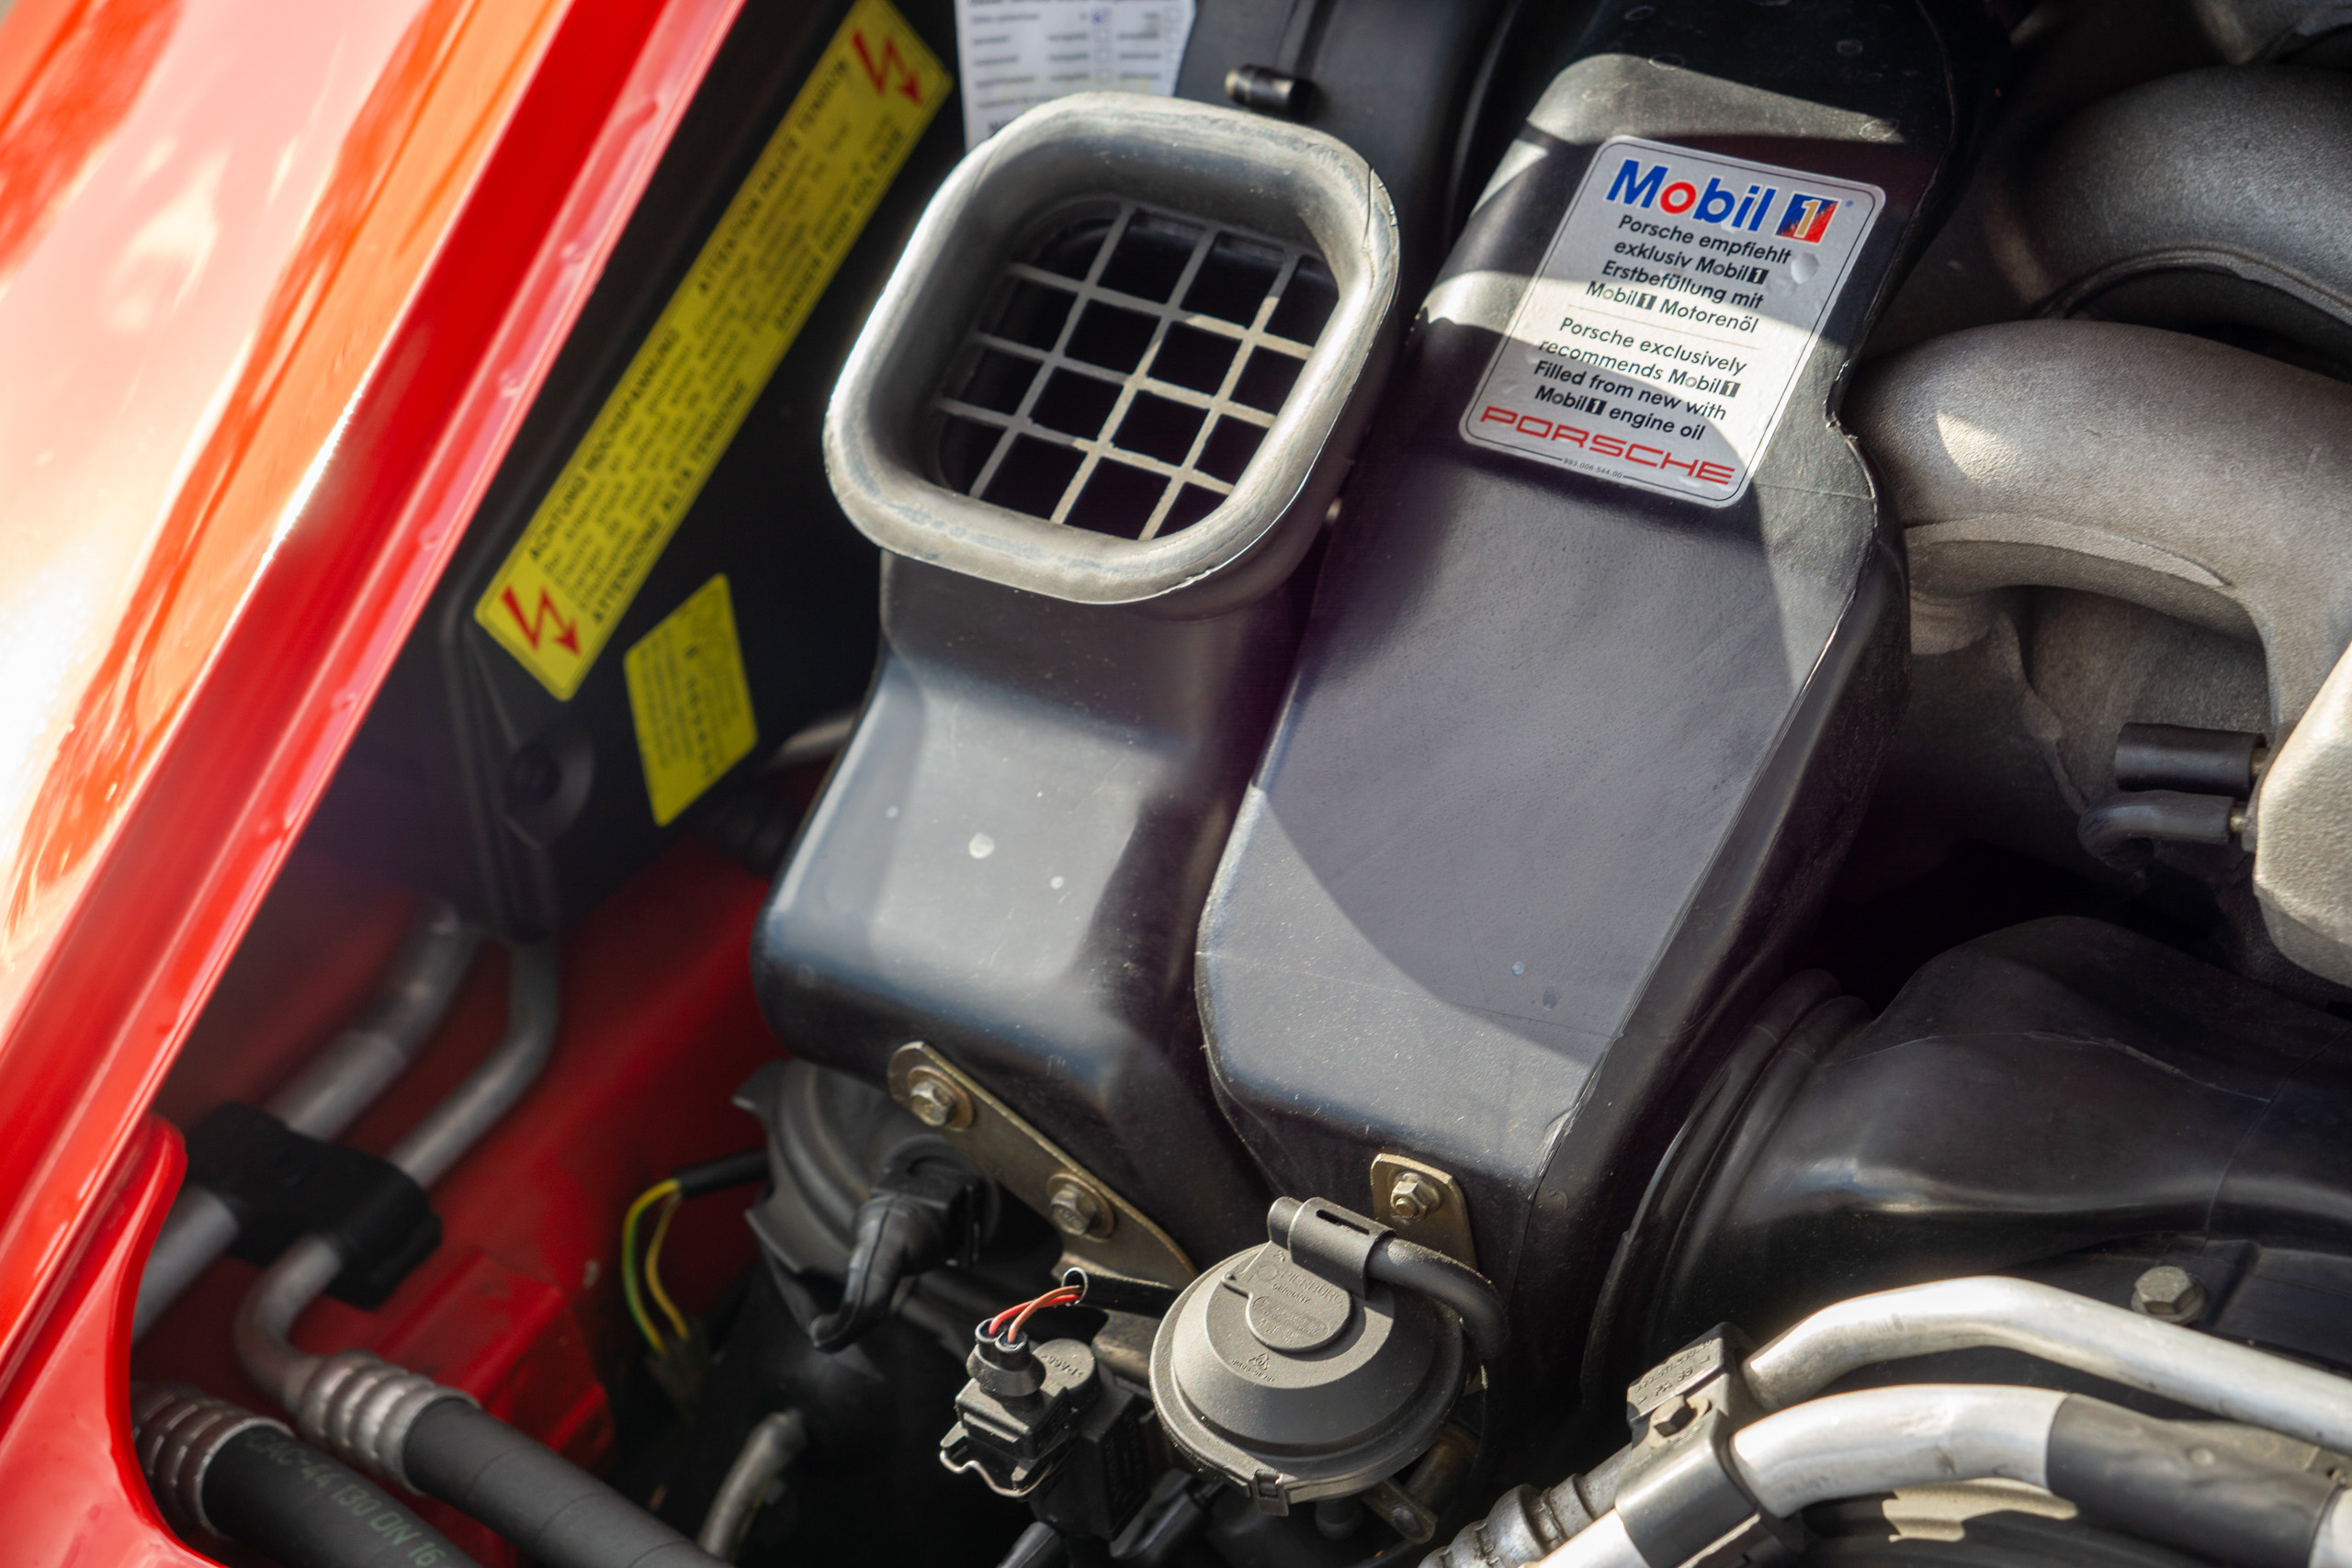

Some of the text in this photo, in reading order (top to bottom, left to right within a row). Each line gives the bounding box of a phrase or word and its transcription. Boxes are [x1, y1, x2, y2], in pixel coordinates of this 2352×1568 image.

[1607, 160, 1776, 231] Mobil
[1614, 241, 1692, 268] exklusiv
[1619, 216, 1792, 265] Porsche empfiehlt
[1602, 261, 1764, 310] Erstbefüllung mit
[1659, 299, 1759, 333] Motorenöl
[1539, 340, 1662, 379] recommends
[1560, 318, 1747, 376] Porsche exclusively
[1534, 361, 1727, 420] Filled from new with
[1480, 406, 1735, 485] PORSCHE
[1609, 405, 1676, 436] engine
[1679, 423, 1705, 441] oil
[369, 1510, 422, 1547] DN
[407, 1540, 447, 1567] 16
